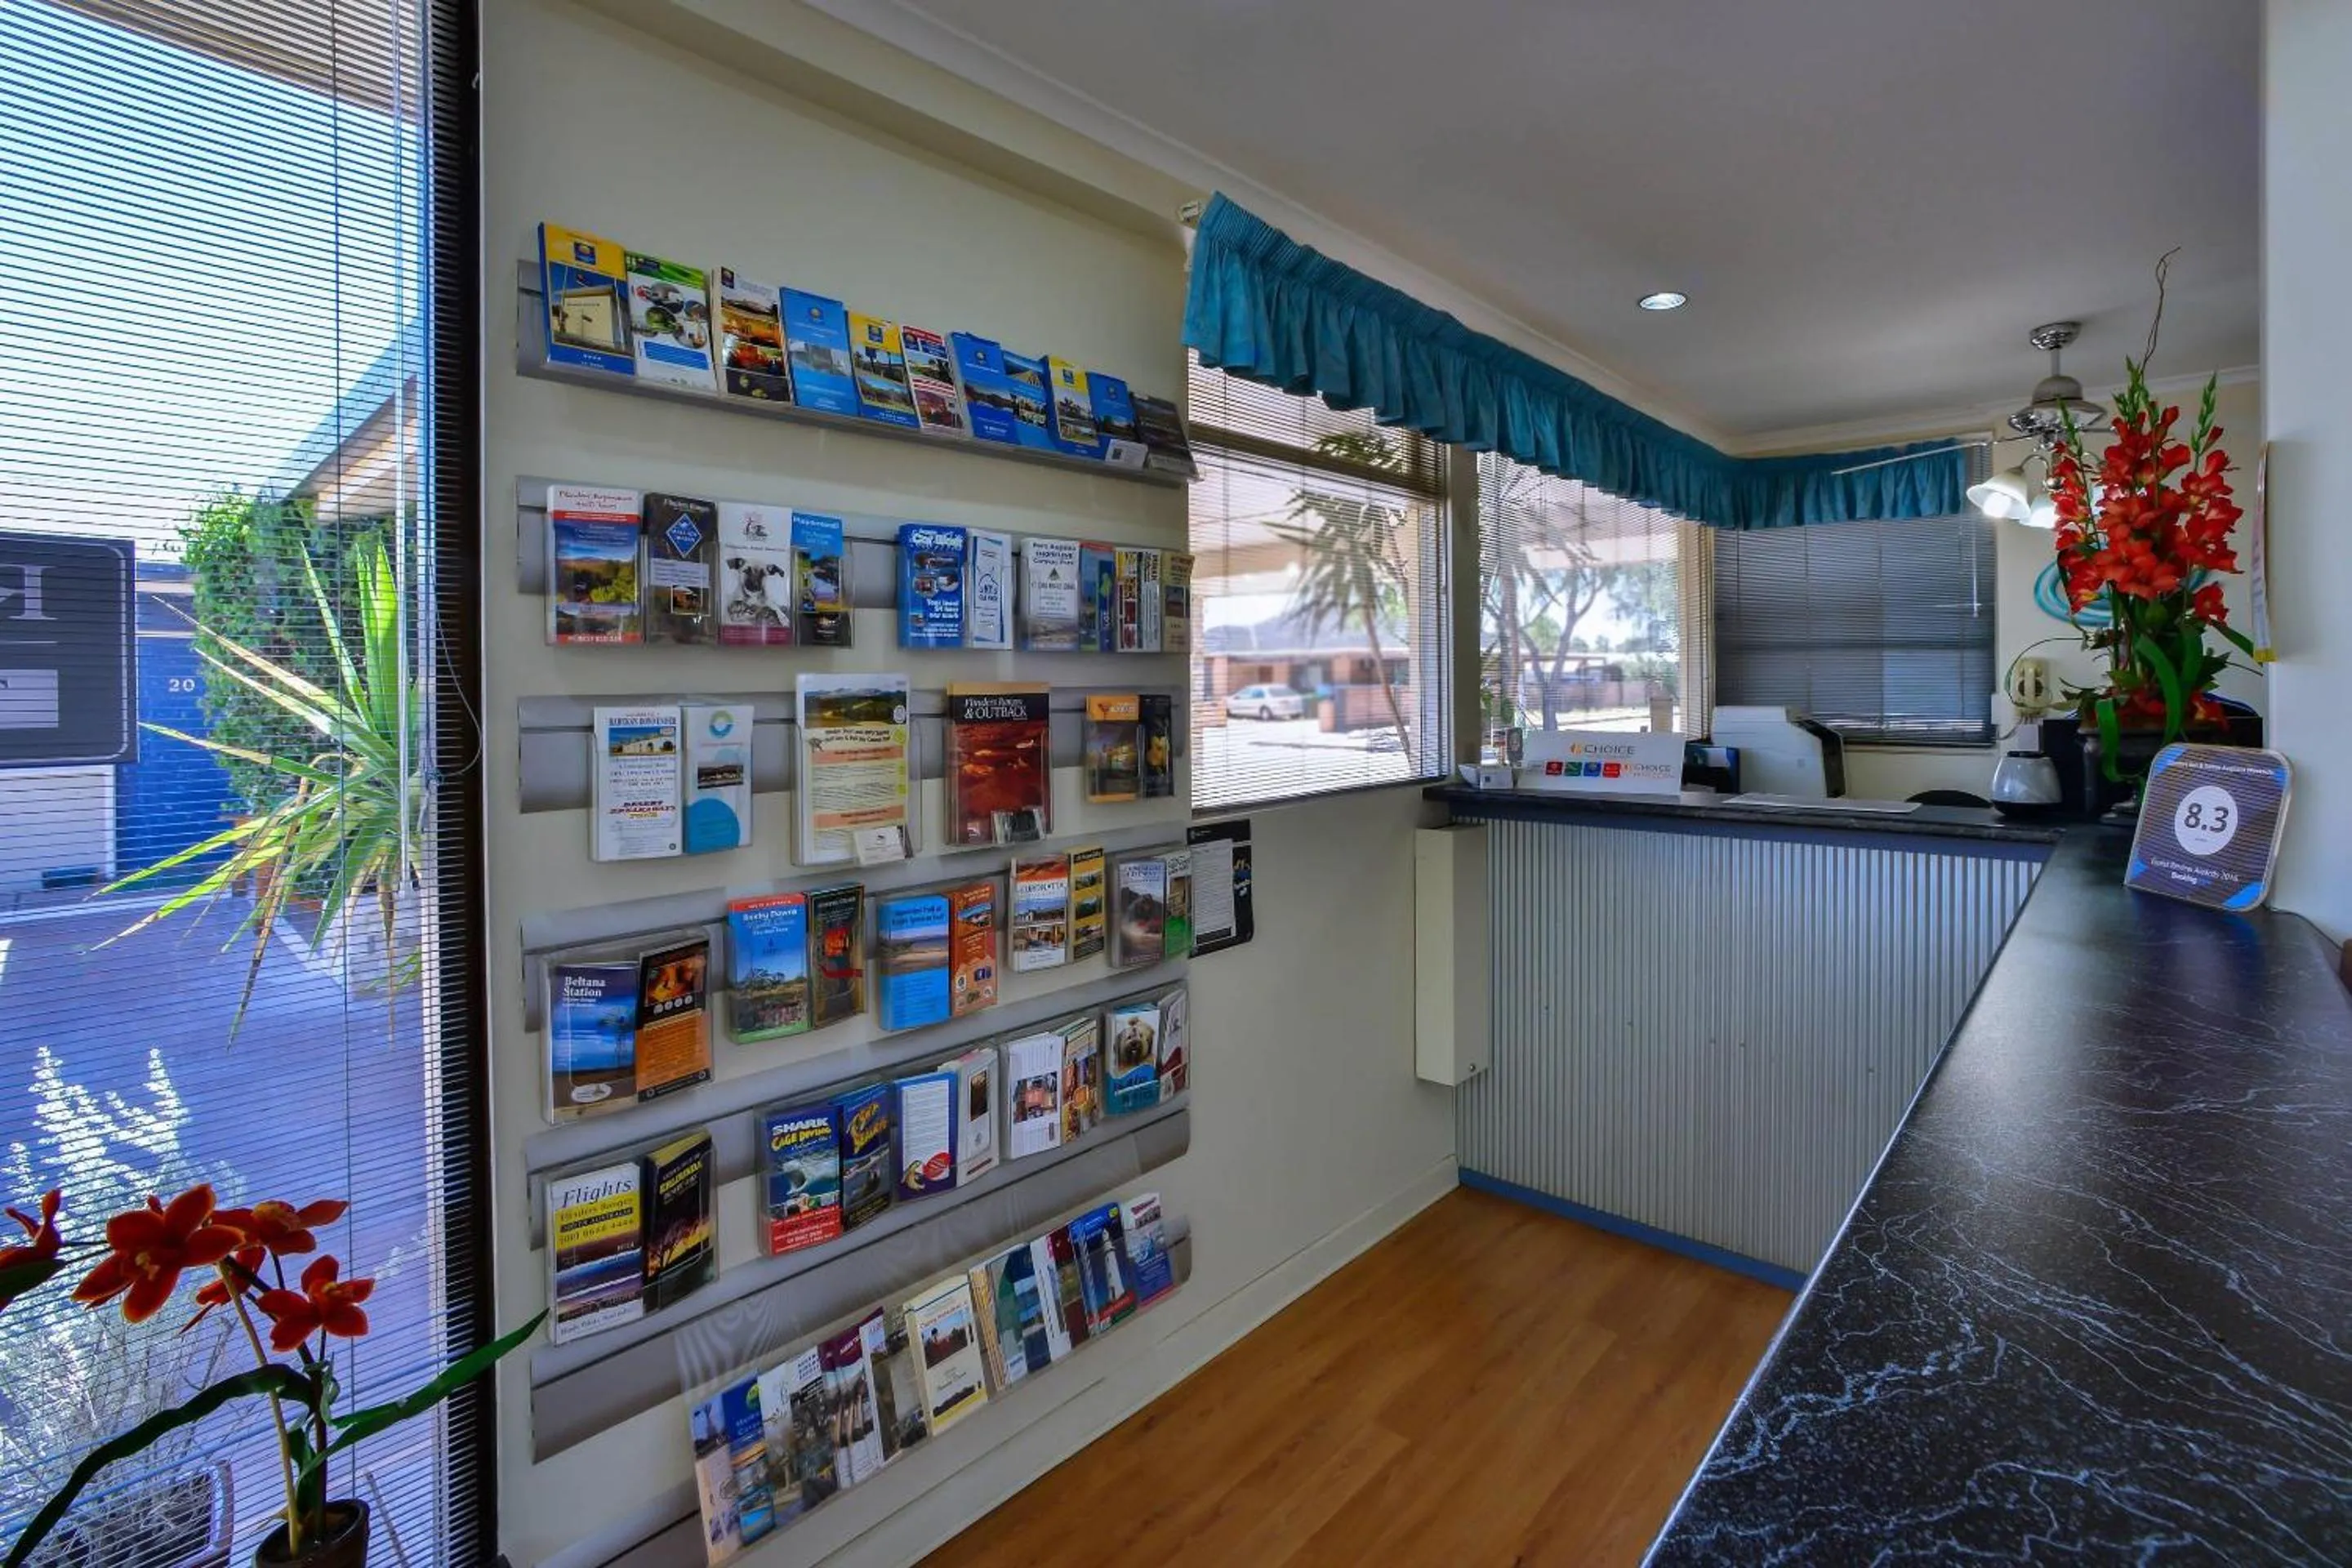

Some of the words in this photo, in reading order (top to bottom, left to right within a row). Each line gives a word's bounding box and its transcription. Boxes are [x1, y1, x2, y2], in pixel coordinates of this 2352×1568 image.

[169, 678, 195, 693] 20
[975, 706, 1027, 719] OUTBACK
[1584, 744, 1637, 755] CHOICE
[2183, 802, 2230, 833] 8.3
[564, 975, 607, 987] Beltana
[562, 985, 602, 997] Station
[772, 1116, 829, 1136] SHARK
[770, 1132, 798, 1152] CAGE
[799, 1126, 832, 1143] DIVING
[560, 1179, 633, 1209] Flights
